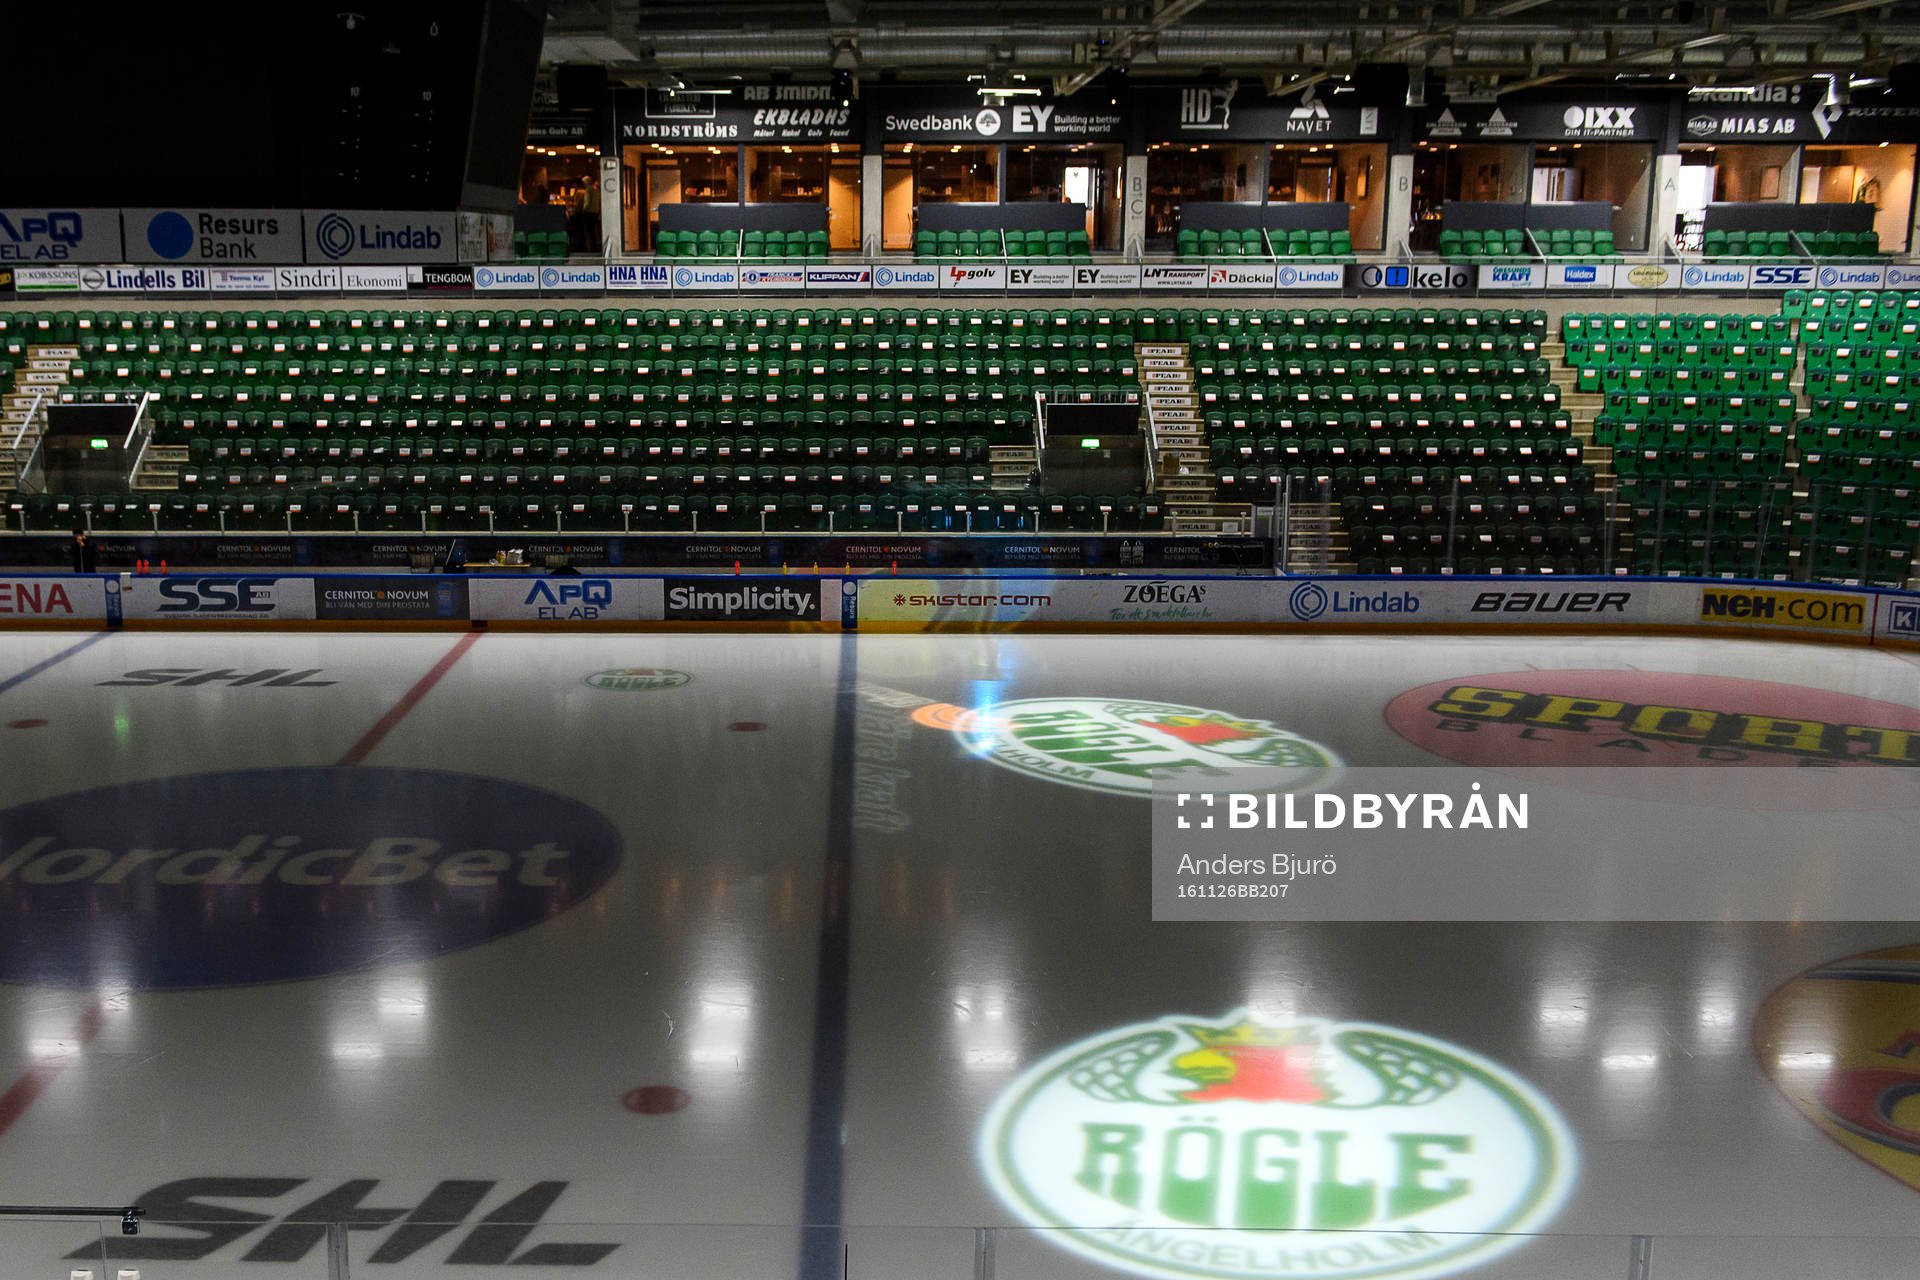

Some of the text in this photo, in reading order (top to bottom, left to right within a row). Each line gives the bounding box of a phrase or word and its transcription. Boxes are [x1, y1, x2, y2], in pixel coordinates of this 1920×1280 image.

[1181, 88, 1212, 123] HD
[752, 108, 851, 126] EKBLADHS
[885, 114, 973, 131] Swedbank
[1012, 105, 1056, 133] EY
[1054, 114, 1088, 126] Building
[1096, 114, 1121, 124] better
[623, 122, 738, 138] NORDSTRÖMS
[1054, 124, 1111, 134] working world
[1286, 120, 1333, 134] NAVET
[1564, 128, 1581, 136] DIN
[1720, 117, 1796, 134] MIAS AB
[604, 178, 616, 194] C
[1132, 176, 1142, 192] B
[1399, 176, 1409, 193] B
[1664, 177, 1676, 192] A
[1131, 199, 1143, 215] C
[198, 213, 279, 235] Resurs
[360, 225, 442, 248] Lindab
[0, 244, 69, 260] EL AB
[200, 237, 257, 259] Bank
[106, 270, 206, 288] Lindells Bil
[280, 269, 337, 288] Sindri
[347, 274, 402, 288] Ekonomi
[424, 273, 472, 284] TENGBOM
[495, 272, 535, 283] Lindab
[561, 272, 601, 283] Lindab
[609, 267, 668, 280] HNA HNA
[695, 272, 734, 283] Lindab
[809, 273, 857, 281] KLIPPAN
[895, 272, 934, 282] Lindab
[967, 269, 995, 279] golv
[1010, 269, 1033, 283] EY
[1077, 269, 1100, 283] EY
[1228, 273, 1274, 284] Däckia
[1299, 271, 1339, 282] Lindab
[1413, 267, 1468, 288] kelo
[1493, 272, 1531, 281] KRAFT
[1566, 270, 1595, 279] Haldex
[1704, 271, 1744, 282] Lindab
[1754, 267, 1813, 284] SSE
[1840, 272, 1880, 283] Lindab
[156, 577, 283, 613] SSE
[324, 591, 429, 600] CERNITOL NOVUM
[669, 586, 816, 616] Simplicity.
[908, 594, 1052, 607] skistar.com
[1333, 591, 1420, 612] Lindab
[1470, 592, 1632, 612] BAUER
[538, 607, 599, 620] EL AB
[95, 668, 340, 688] SHL
[1074, 1113, 1475, 1234] RÖGLE
[59, 1176, 623, 1266] SHL
